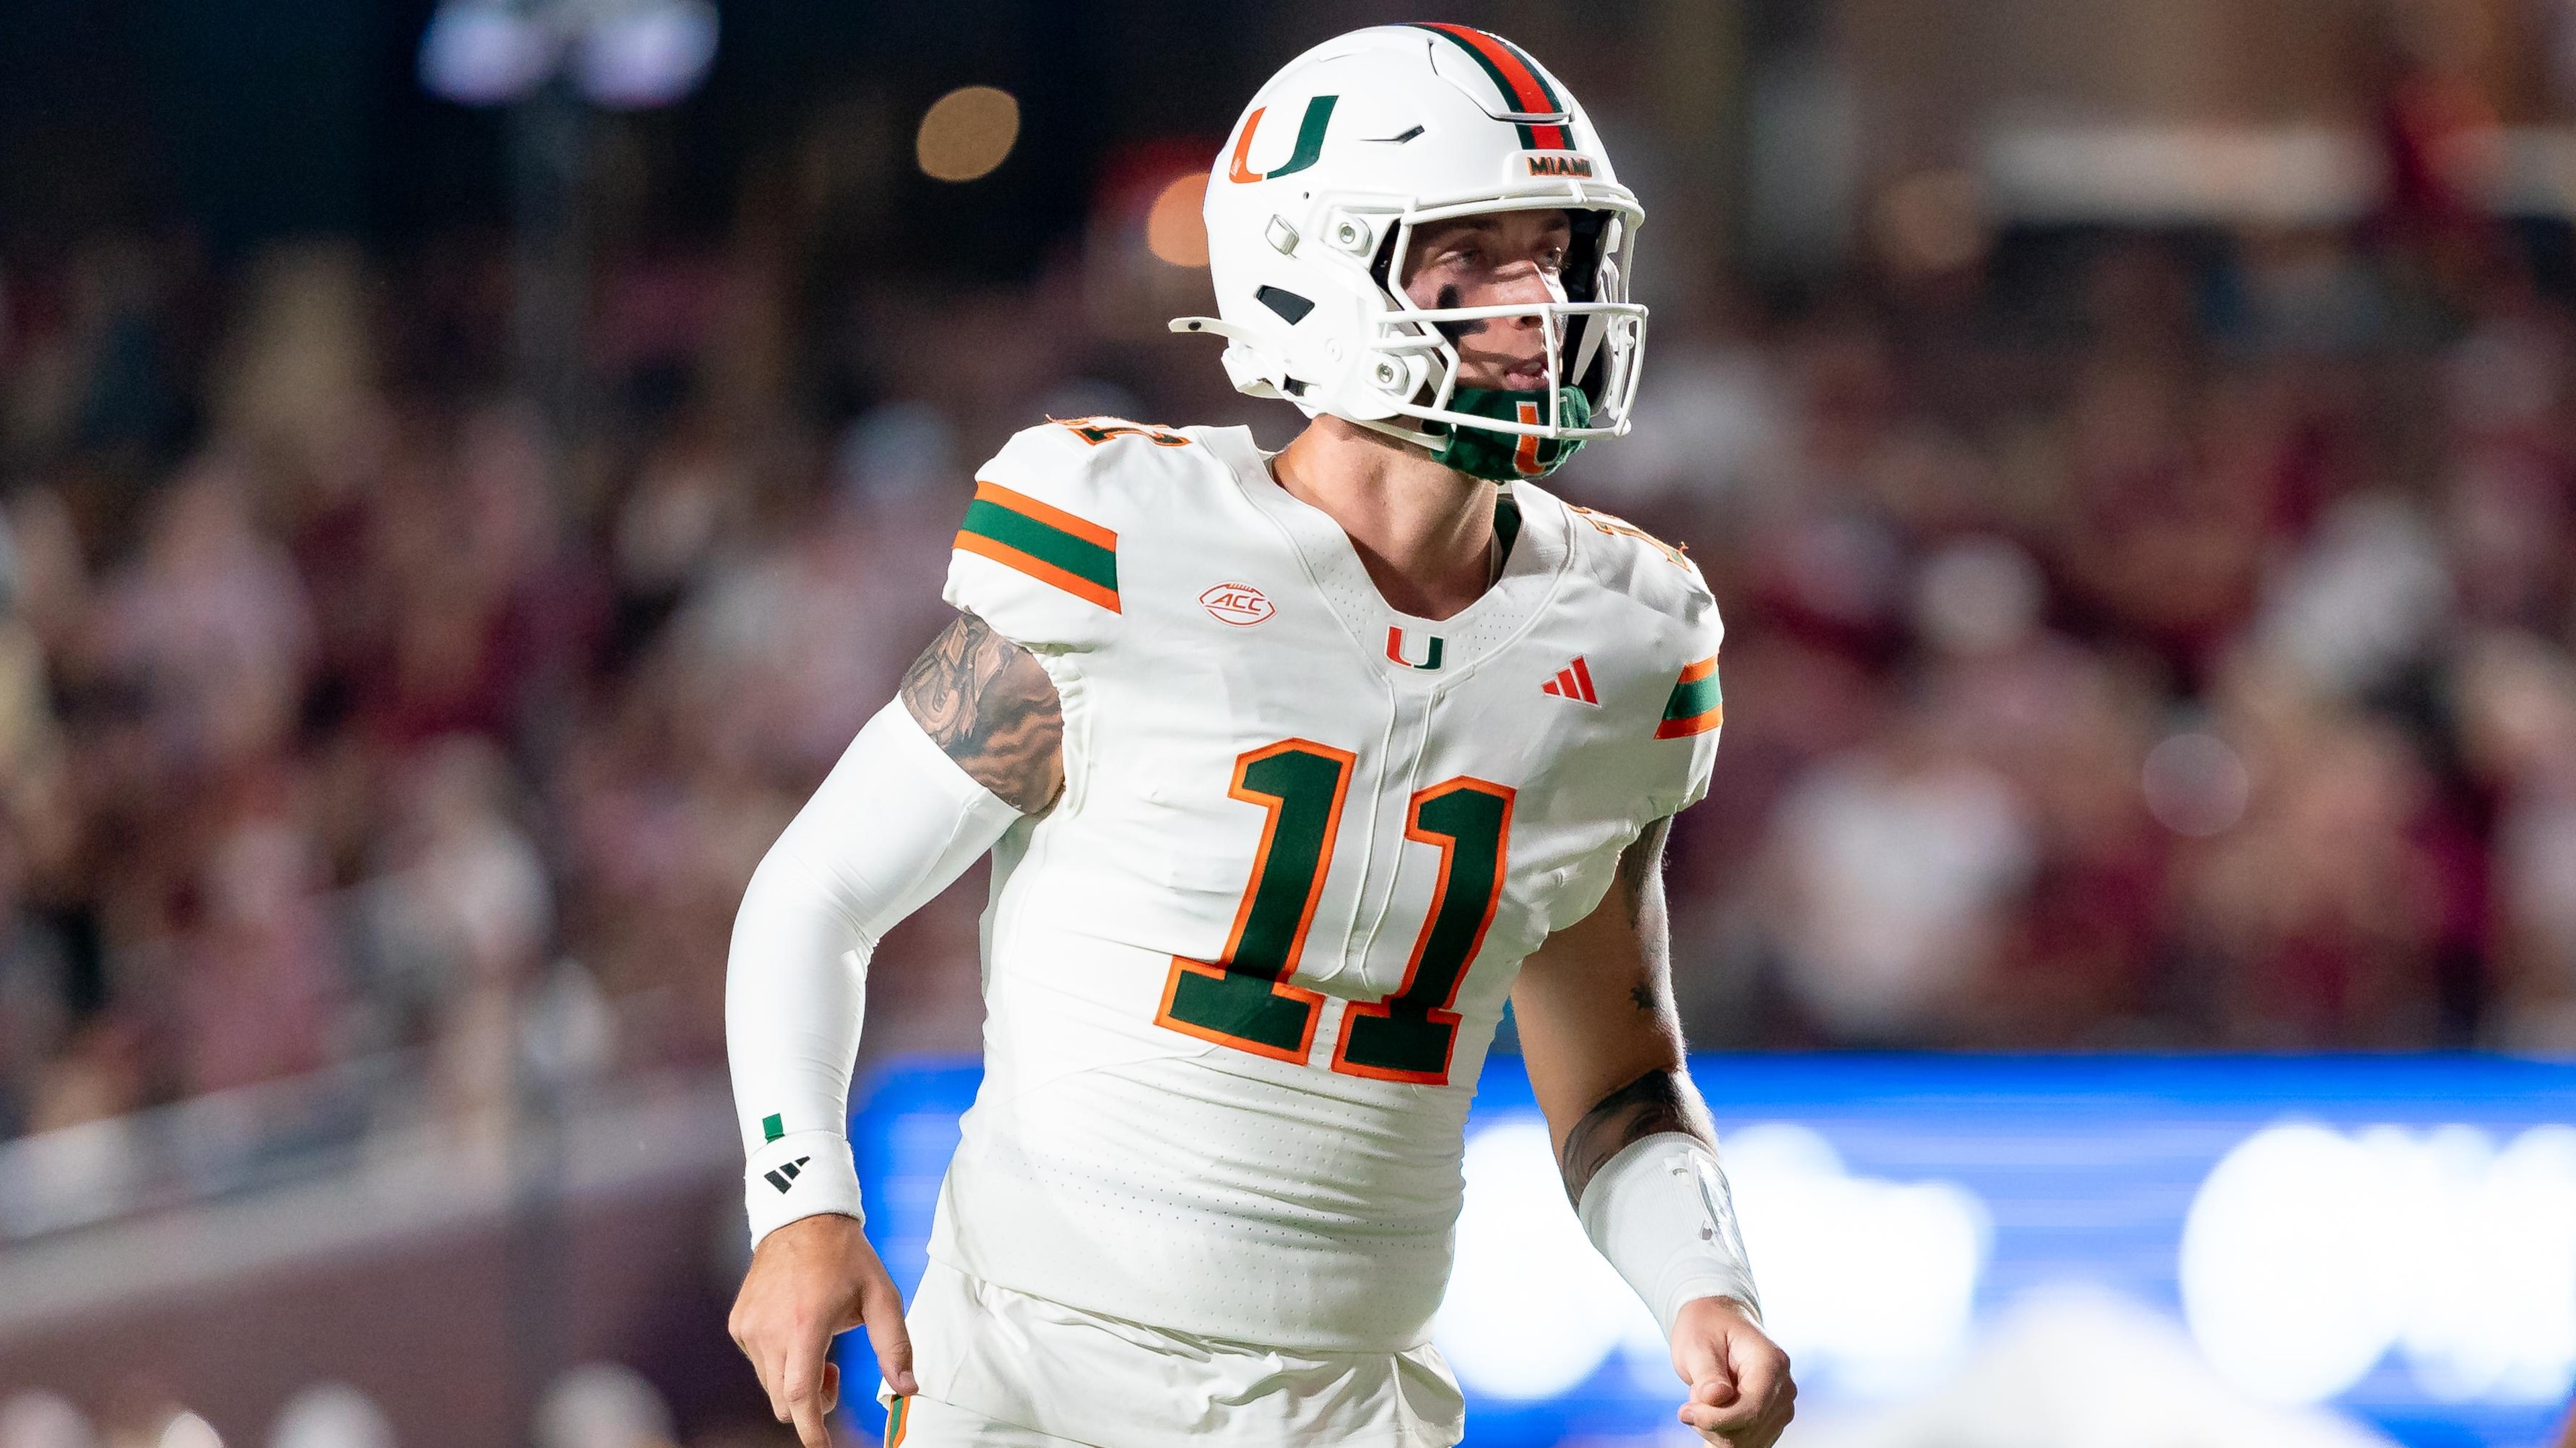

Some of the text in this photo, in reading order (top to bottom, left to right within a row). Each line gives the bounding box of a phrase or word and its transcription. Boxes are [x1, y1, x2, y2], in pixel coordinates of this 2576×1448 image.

[1229, 95, 1340, 184] U
[1525, 156, 1593, 178] MIAMI
[1211, 593, 1266, 612] ACC
[1385, 625, 1444, 671] U
[1152, 737, 1517, 1086] 11
